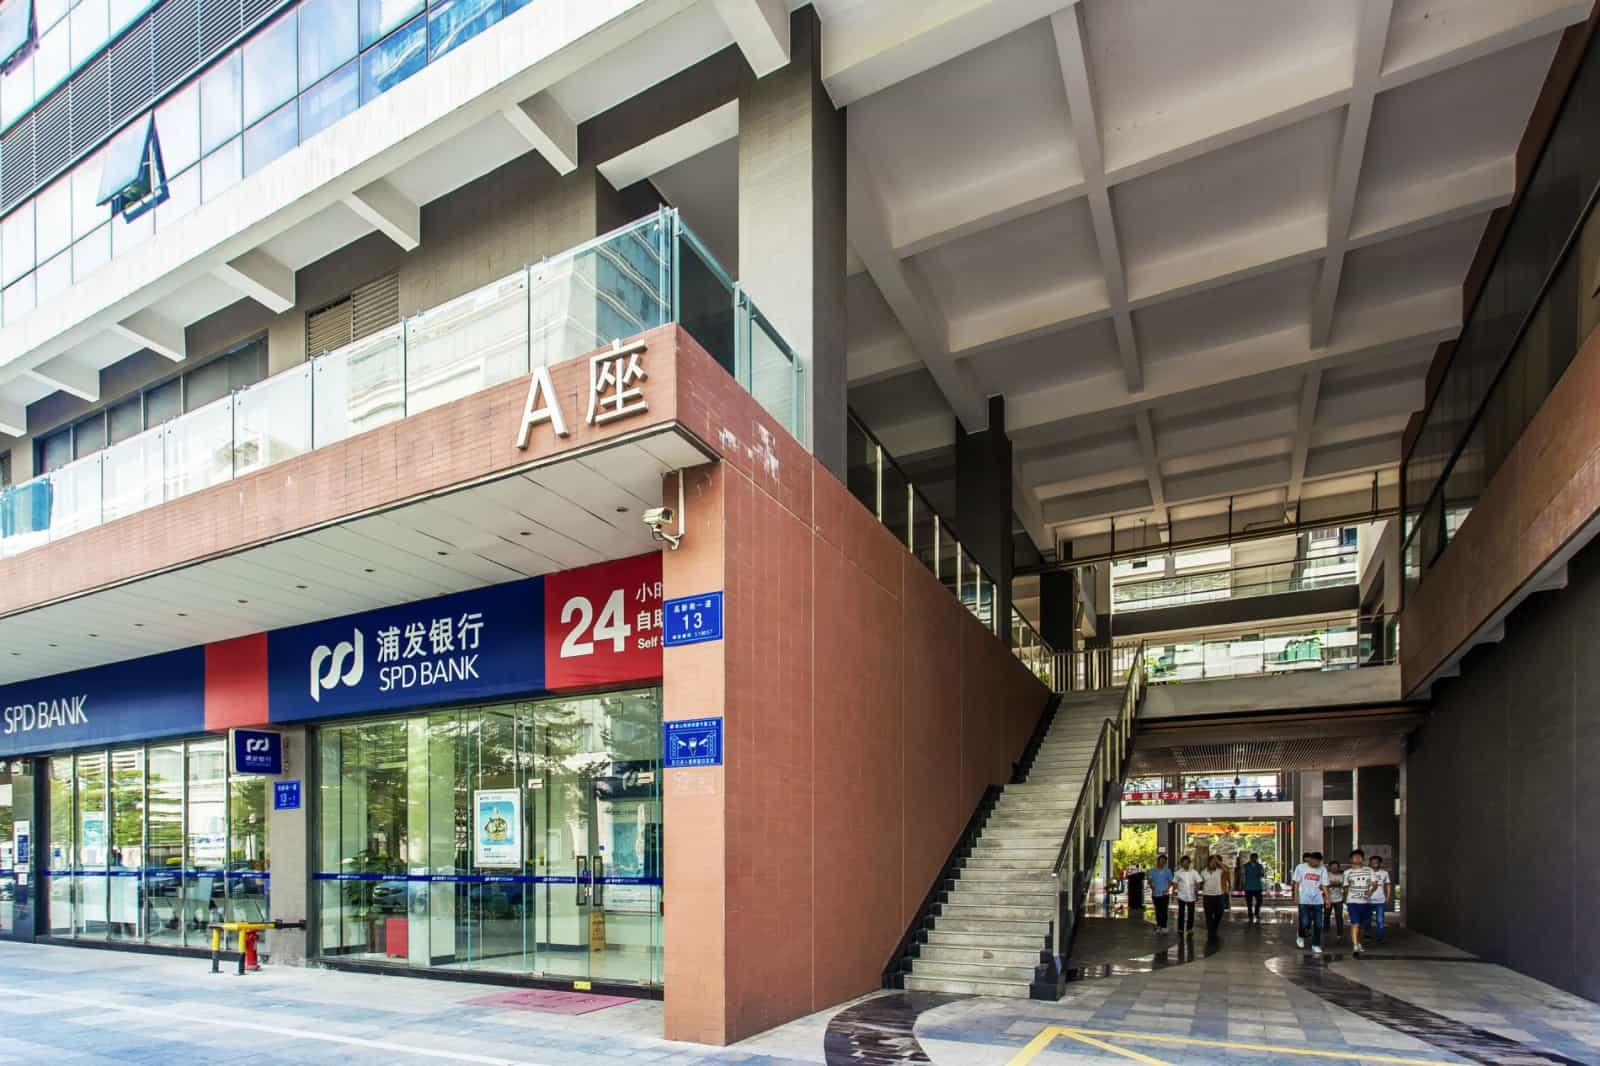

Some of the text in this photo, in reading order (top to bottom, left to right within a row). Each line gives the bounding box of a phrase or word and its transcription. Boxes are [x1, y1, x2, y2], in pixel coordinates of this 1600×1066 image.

[376, 612, 484, 663] 浦发银行
[560, 588, 632, 659] 24
[682, 612, 703, 631] 13
[637, 636, 658, 649] Self
[379, 653, 480, 692] SPD BANK
[4, 694, 89, 735] SPD BANK
